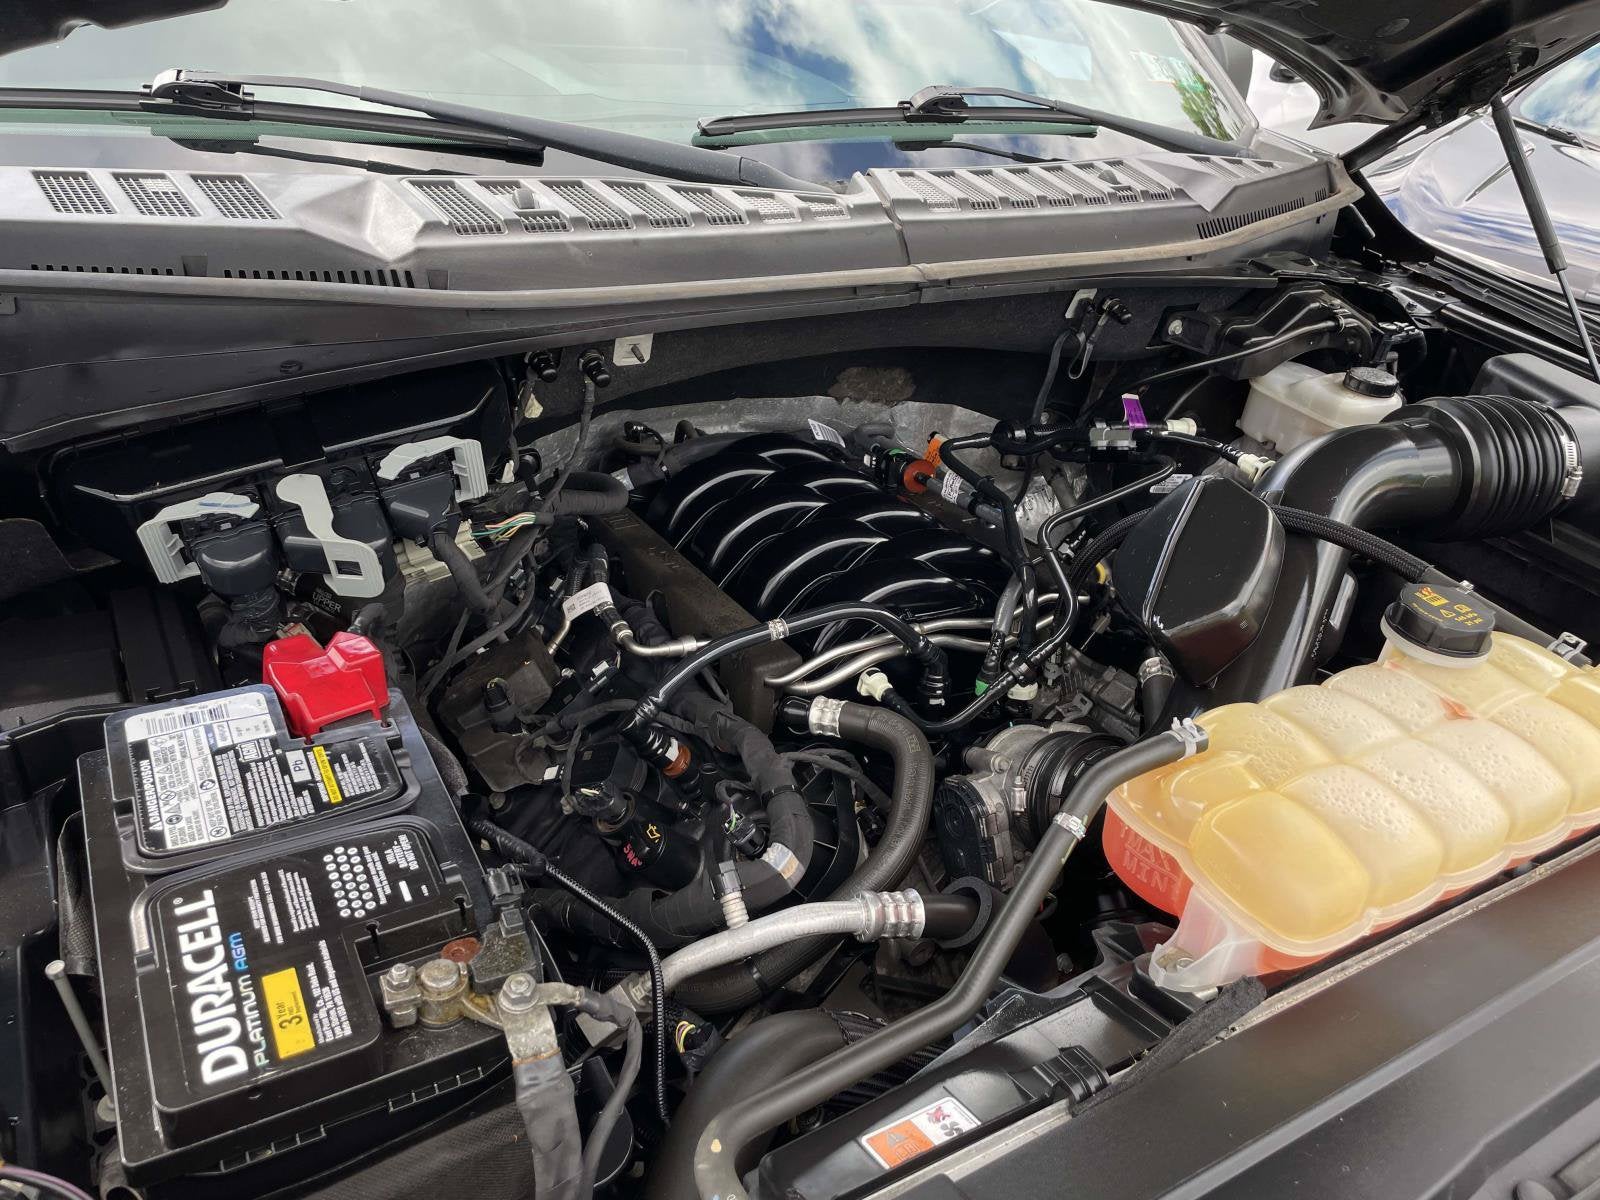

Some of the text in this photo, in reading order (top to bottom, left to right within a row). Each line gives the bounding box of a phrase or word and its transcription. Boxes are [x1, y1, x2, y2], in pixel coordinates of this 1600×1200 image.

[312, 592, 342, 613] UPPER
[291, 759, 305, 772] Pb
[139, 760, 160, 822] DANGER/POISON
[392, 845, 408, 868] BATTERY
[404, 849, 415, 861] NOT
[1123, 851, 1168, 893] MIN
[173, 890, 248, 1084] DURACELL
[229, 932, 269, 1066] PLATINUM AGM
[274, 1001, 303, 1029] 3 Year
